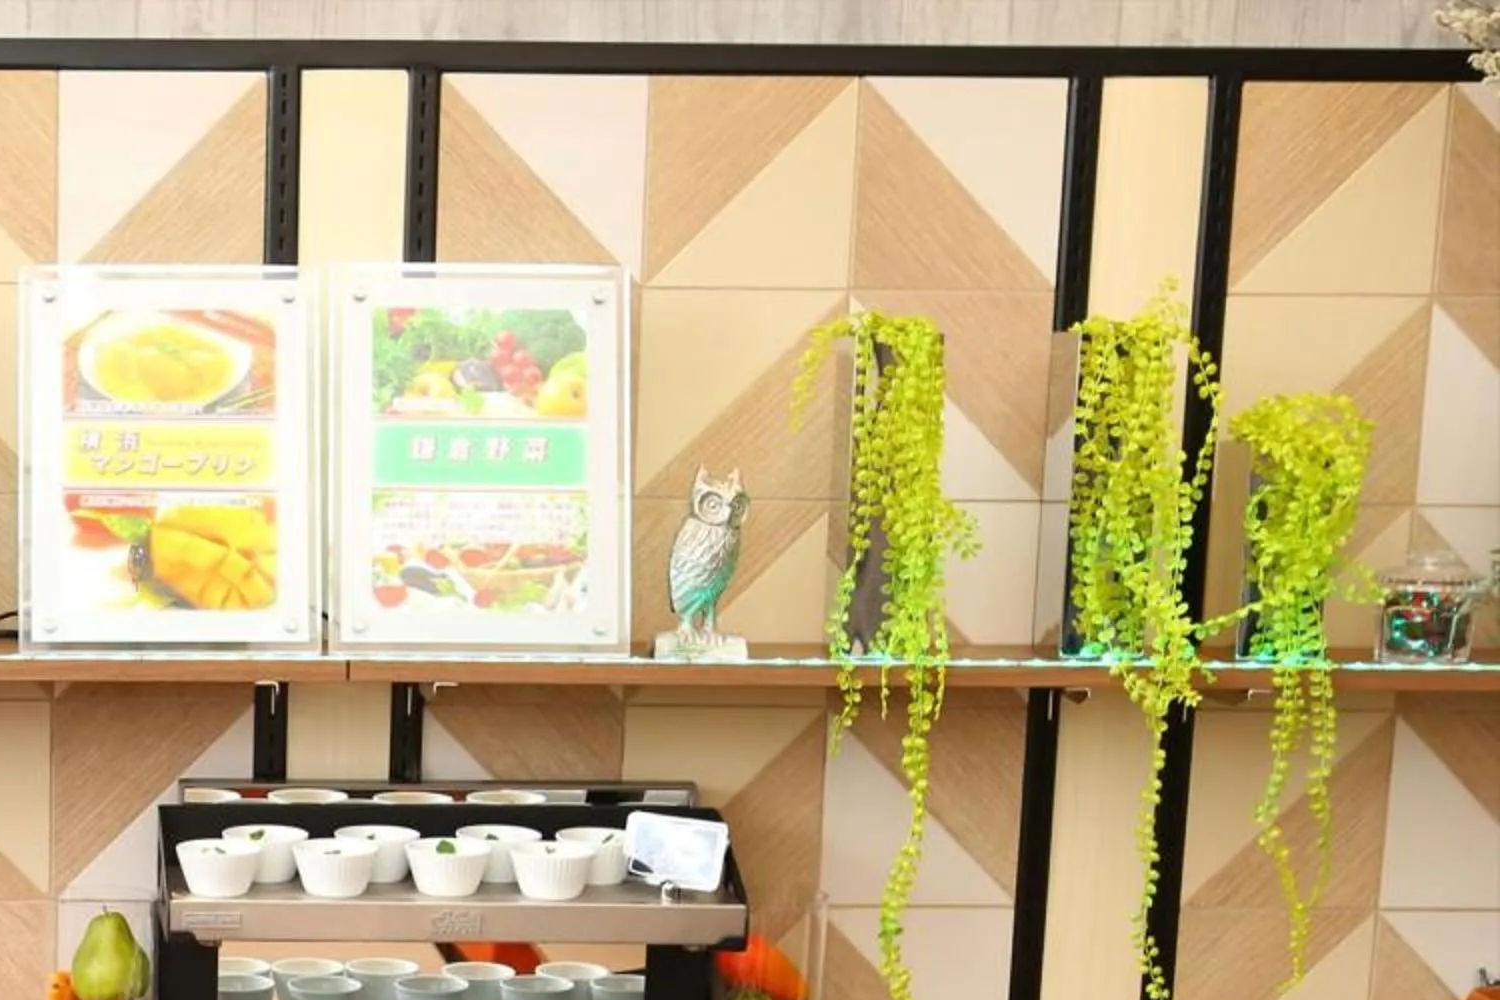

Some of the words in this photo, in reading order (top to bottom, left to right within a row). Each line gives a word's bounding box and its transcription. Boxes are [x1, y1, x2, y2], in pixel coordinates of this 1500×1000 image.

[90, 453, 256, 476] マンゴープリン
